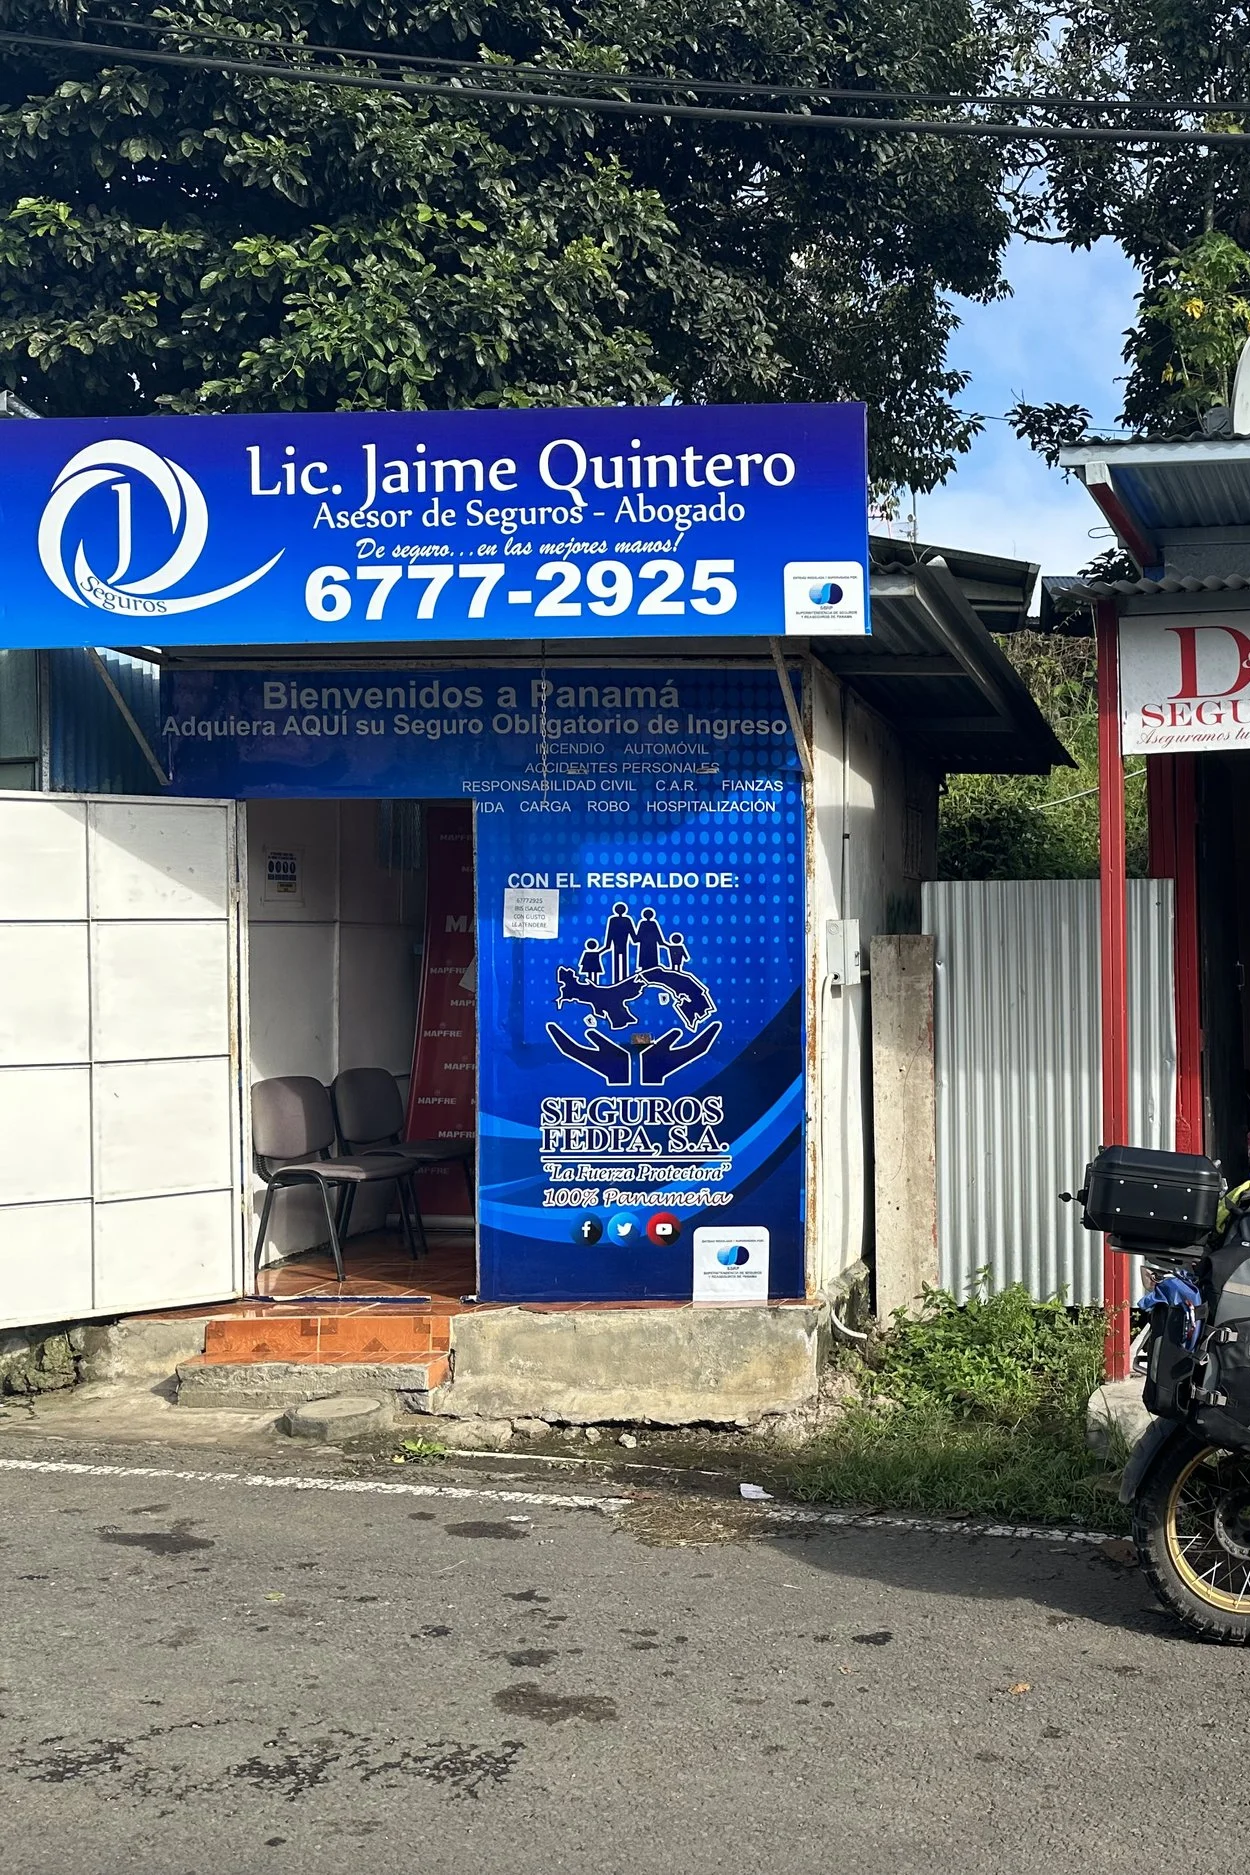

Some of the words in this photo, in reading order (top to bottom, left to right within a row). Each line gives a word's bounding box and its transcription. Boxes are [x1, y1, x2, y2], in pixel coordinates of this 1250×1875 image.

[246, 445, 342, 495] Lic.
[360, 443, 518, 511] Jaime
[539, 438, 796, 506] Quintero
[313, 502, 412, 529] Asesor
[422, 497, 457, 527] de
[466, 499, 583, 535] Seguros
[614, 492, 745, 532] Abogado
[356, 538, 385, 559] De
[504, 536, 533, 556] las
[539, 536, 607, 560] mejores
[615, 532, 684, 554] manos!
[80, 575, 167, 614] Seguros
[305, 559, 738, 622] 6777-2925
[263, 680, 482, 709] Bienvenidos
[497, 688, 517, 708] a
[531, 679, 679, 708] Panamá
[162, 716, 275, 740] Adquiera
[283, 710, 348, 736] AQUÍ
[355, 719, 384, 735] su
[394, 714, 483, 740] Seguro
[493, 714, 639, 737] Obligatorio
[648, 713, 678, 735] de
[688, 714, 787, 739] Ingreso
[535, 743, 604, 754] INCENDIO
[624, 741, 709, 754] AUTOMÓVIL
[1136, 729, 1230, 748] Aseguramos
[1236, 727, 1250, 739] tu
[525, 762, 618, 774] ACCIDENTES
[622, 762, 720, 773] PERSONALES
[462, 780, 596, 792] RESPONSABILIDAD
[601, 780, 637, 791] CIVIL
[656, 780, 698, 791] C.A.R.
[722, 780, 783, 791] FIANZAS
[520, 801, 571, 812] CARGA
[588, 801, 630, 812] ROBO
[647, 799, 776, 812] HOSPITALIZACIÓN
[508, 873, 548, 888] CON
[556, 873, 581, 888] EL
[587, 872, 699, 888] RESPALDO
[705, 873, 739, 888] DE:
[418, 1097, 456, 1105] MAPFRE
[540, 1096, 724, 1126] SEGUROS
[539, 1126, 662, 1156] FEDPA,
[668, 1126, 730, 1152] S.A.
[577, 1164, 634, 1182] Fuerza
[543, 1188, 598, 1207] 100%
[604, 1188, 733, 1206] Panameña
